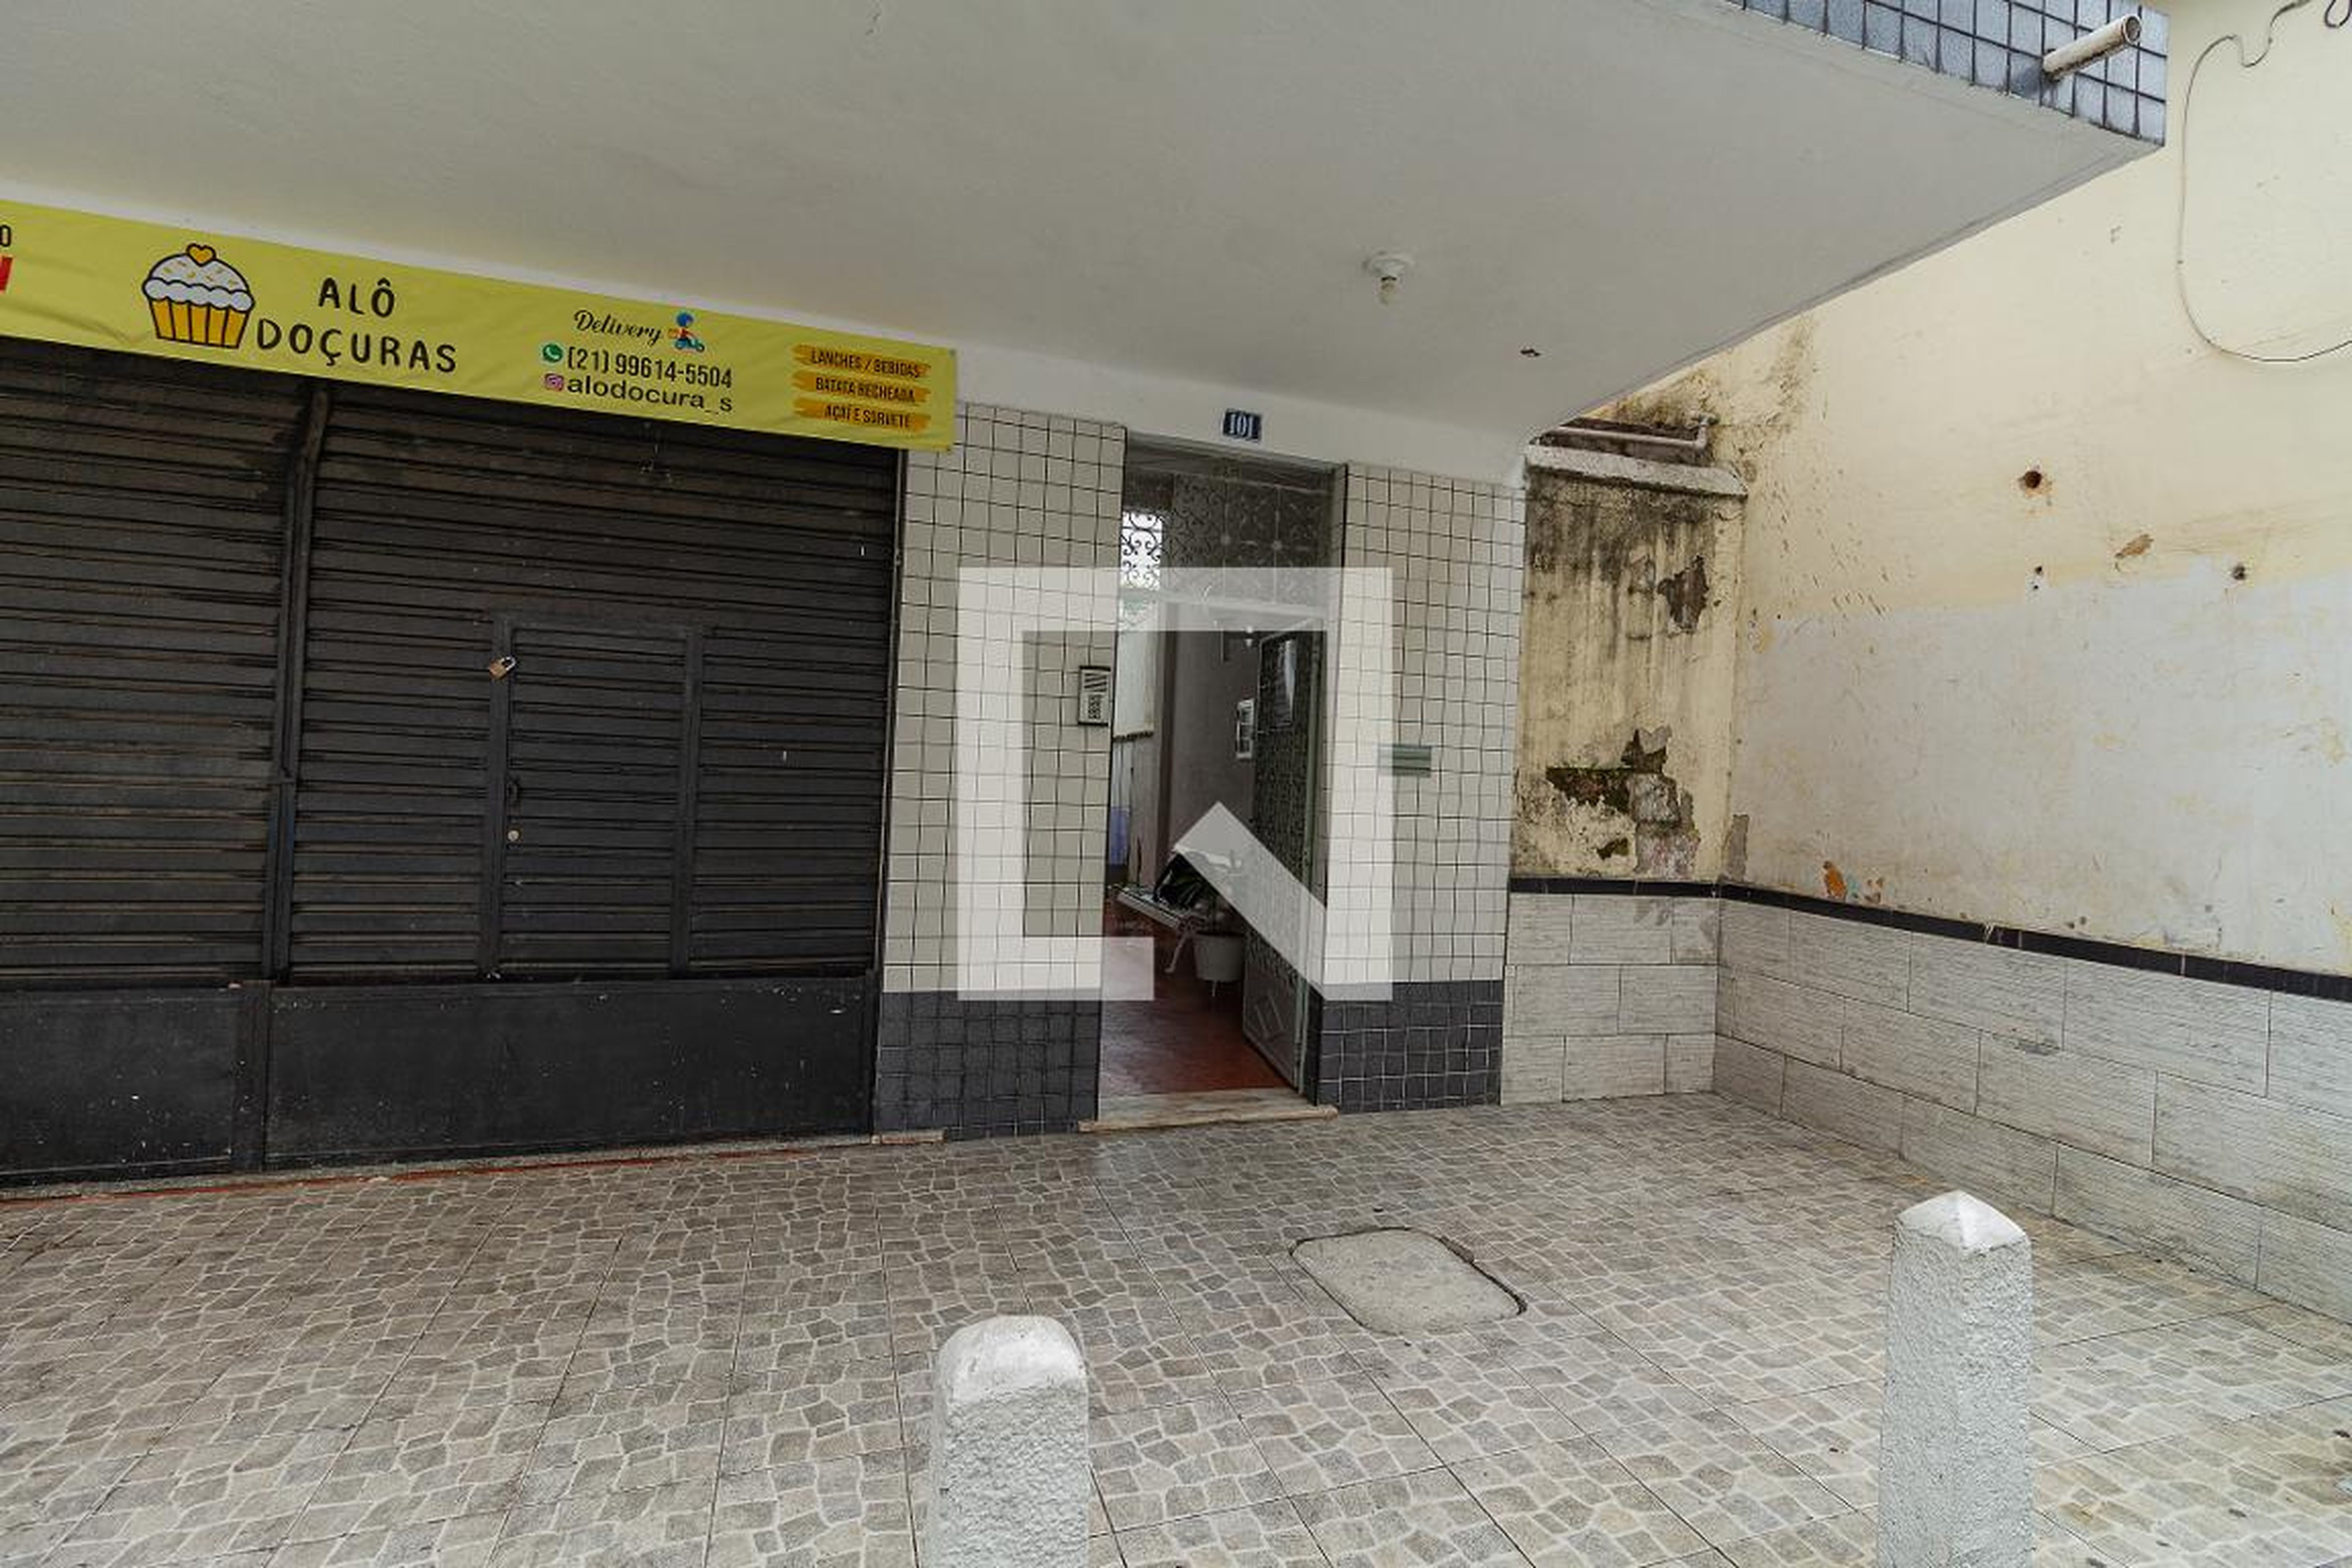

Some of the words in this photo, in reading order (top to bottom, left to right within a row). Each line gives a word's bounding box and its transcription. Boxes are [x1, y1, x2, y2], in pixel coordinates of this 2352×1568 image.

[318, 277, 394, 317] ALÔ
[573, 309, 662, 345] Delivery
[257, 318, 456, 373] DOÇURAS
[568, 347, 609, 373] (21)
[615, 353, 732, 388] 99614-5504
[812, 350, 861, 370] LANCHES
[874, 358, 920, 378] BEBIDAS
[816, 377, 855, 394] BATATA
[857, 383, 915, 402] RECHEADA
[854, 408, 861, 421] E
[1229, 414, 1254, 438] 101
